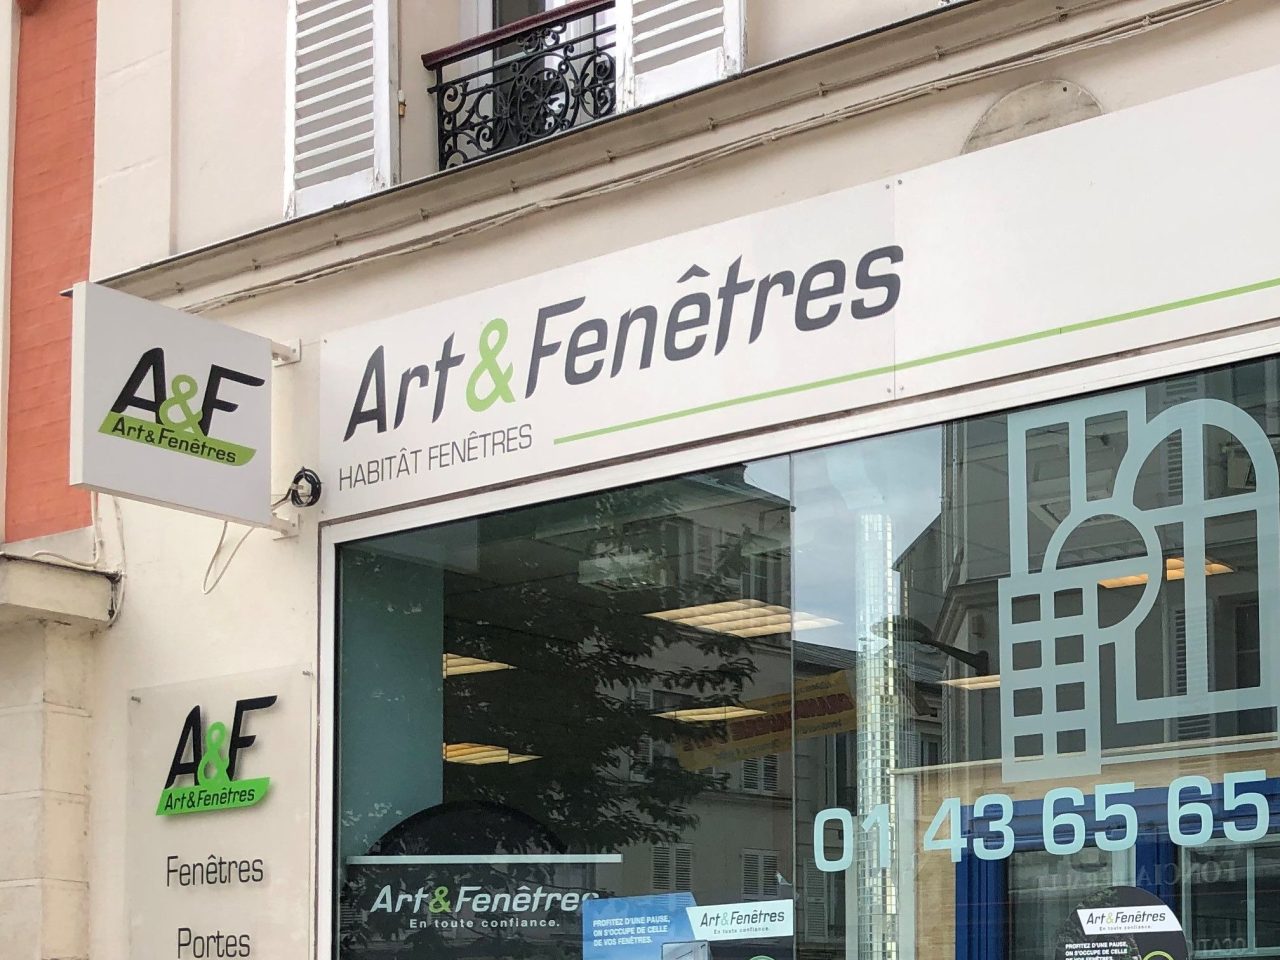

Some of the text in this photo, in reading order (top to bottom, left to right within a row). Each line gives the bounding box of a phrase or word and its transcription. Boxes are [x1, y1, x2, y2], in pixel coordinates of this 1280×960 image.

[343, 245, 904, 442] Art&Fenêtres
[110, 347, 265, 440] A&F
[112, 416, 236, 463] Art&Fenêtres
[338, 424, 533, 491] HABITÂT FENÊTRES
[164, 695, 278, 789] A&F
[164, 787, 255, 811] Art&Fenêtres
[814, 804, 891, 872] 01
[923, 793, 1014, 864] 43
[1042, 782, 1138, 856] 65
[1167, 770, 1270, 847] 65
[166, 854, 264, 887] Fenêtres
[409, 917, 560, 928] En toute confiance.
[592, 918, 623, 927] PROFITEZ
[593, 929, 602, 937] ON
[647, 925, 668, 933] CELLE
[700, 909, 785, 927] Art&Fenêtres
[1086, 911, 1166, 924] Art&Fenêtres
[177, 927, 250, 959] Portes
[603, 938, 617, 946] VOS
